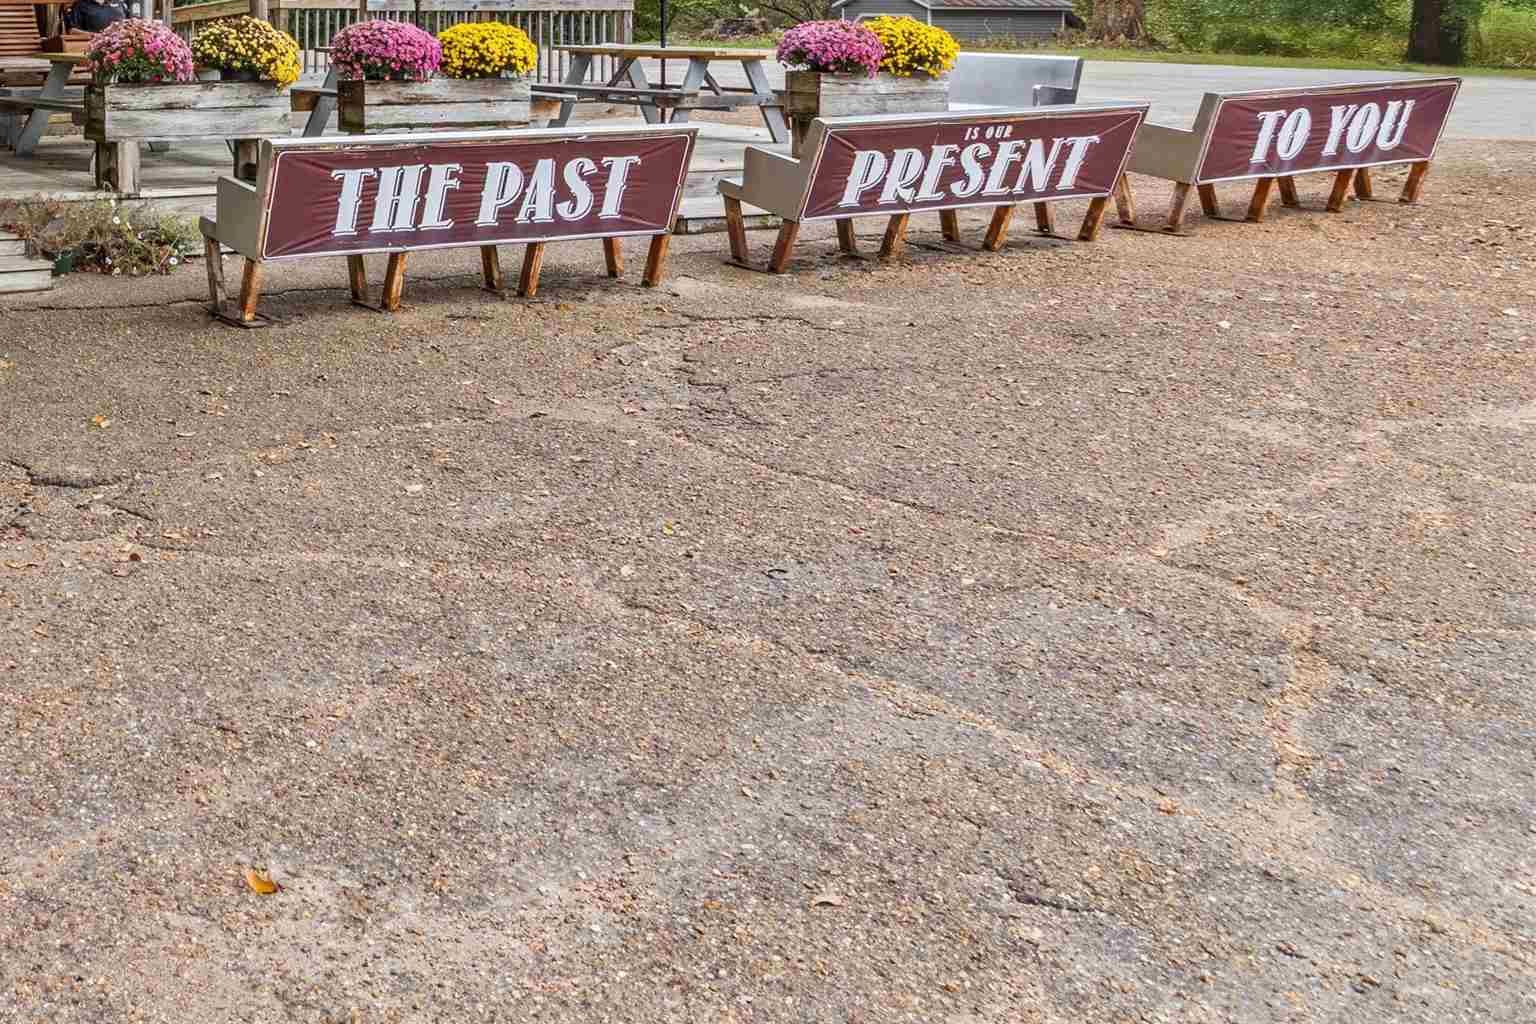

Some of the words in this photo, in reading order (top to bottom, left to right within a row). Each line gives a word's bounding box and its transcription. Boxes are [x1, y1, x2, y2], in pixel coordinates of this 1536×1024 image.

[964, 127, 979, 140] IS
[985, 125, 1013, 139] OUR
[1249, 107, 1312, 163] TO
[1321, 99, 1415, 157] YOU
[331, 163, 463, 236] THE
[475, 155, 641, 226] PAST
[838, 136, 1101, 207] PRESENT
